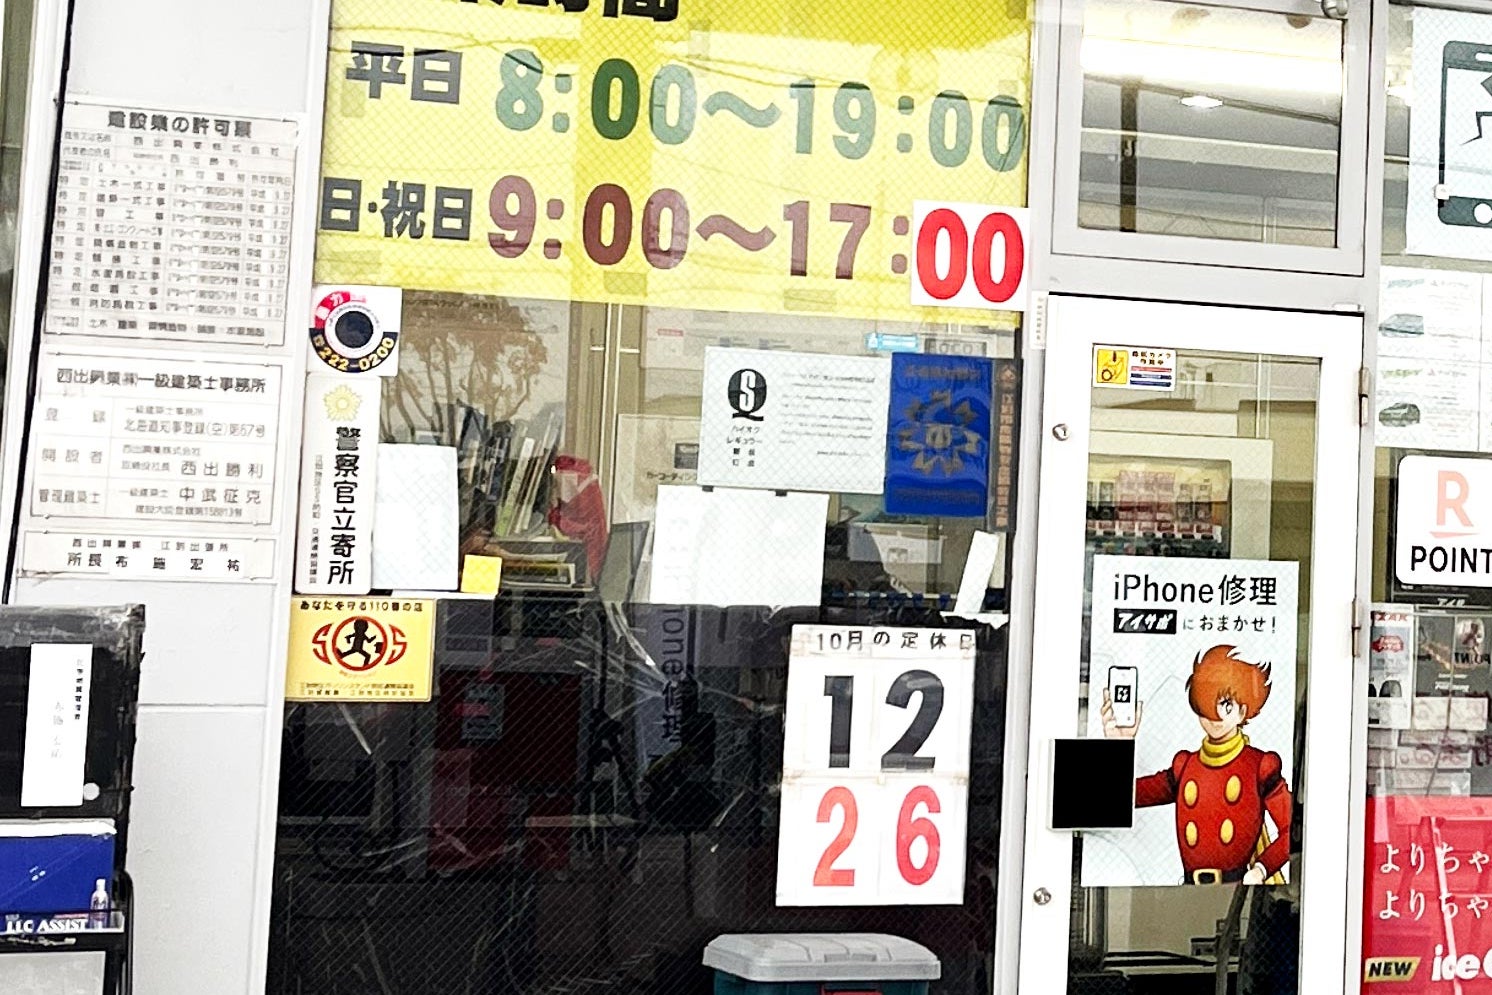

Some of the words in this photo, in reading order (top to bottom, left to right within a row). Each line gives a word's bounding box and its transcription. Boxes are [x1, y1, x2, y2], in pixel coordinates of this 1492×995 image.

[346, 40, 463, 105] 平日
[320, 176, 473, 241] 日・祝日
[327, 426, 362, 585] 警察官立寄所
[1436, 469, 1474, 527] R
[1114, 573, 1278, 606] iPhone修理
[816, 630, 976, 652] 10月の定休日
[1117, 612, 1174, 631] アイサポ
[1182, 615, 1276, 634] におまかせ！
[822, 668, 946, 773] 12
[812, 785, 942, 888] 26
[37, 918, 89, 934] ASSIST
[1367, 960, 1413, 978] NEW
